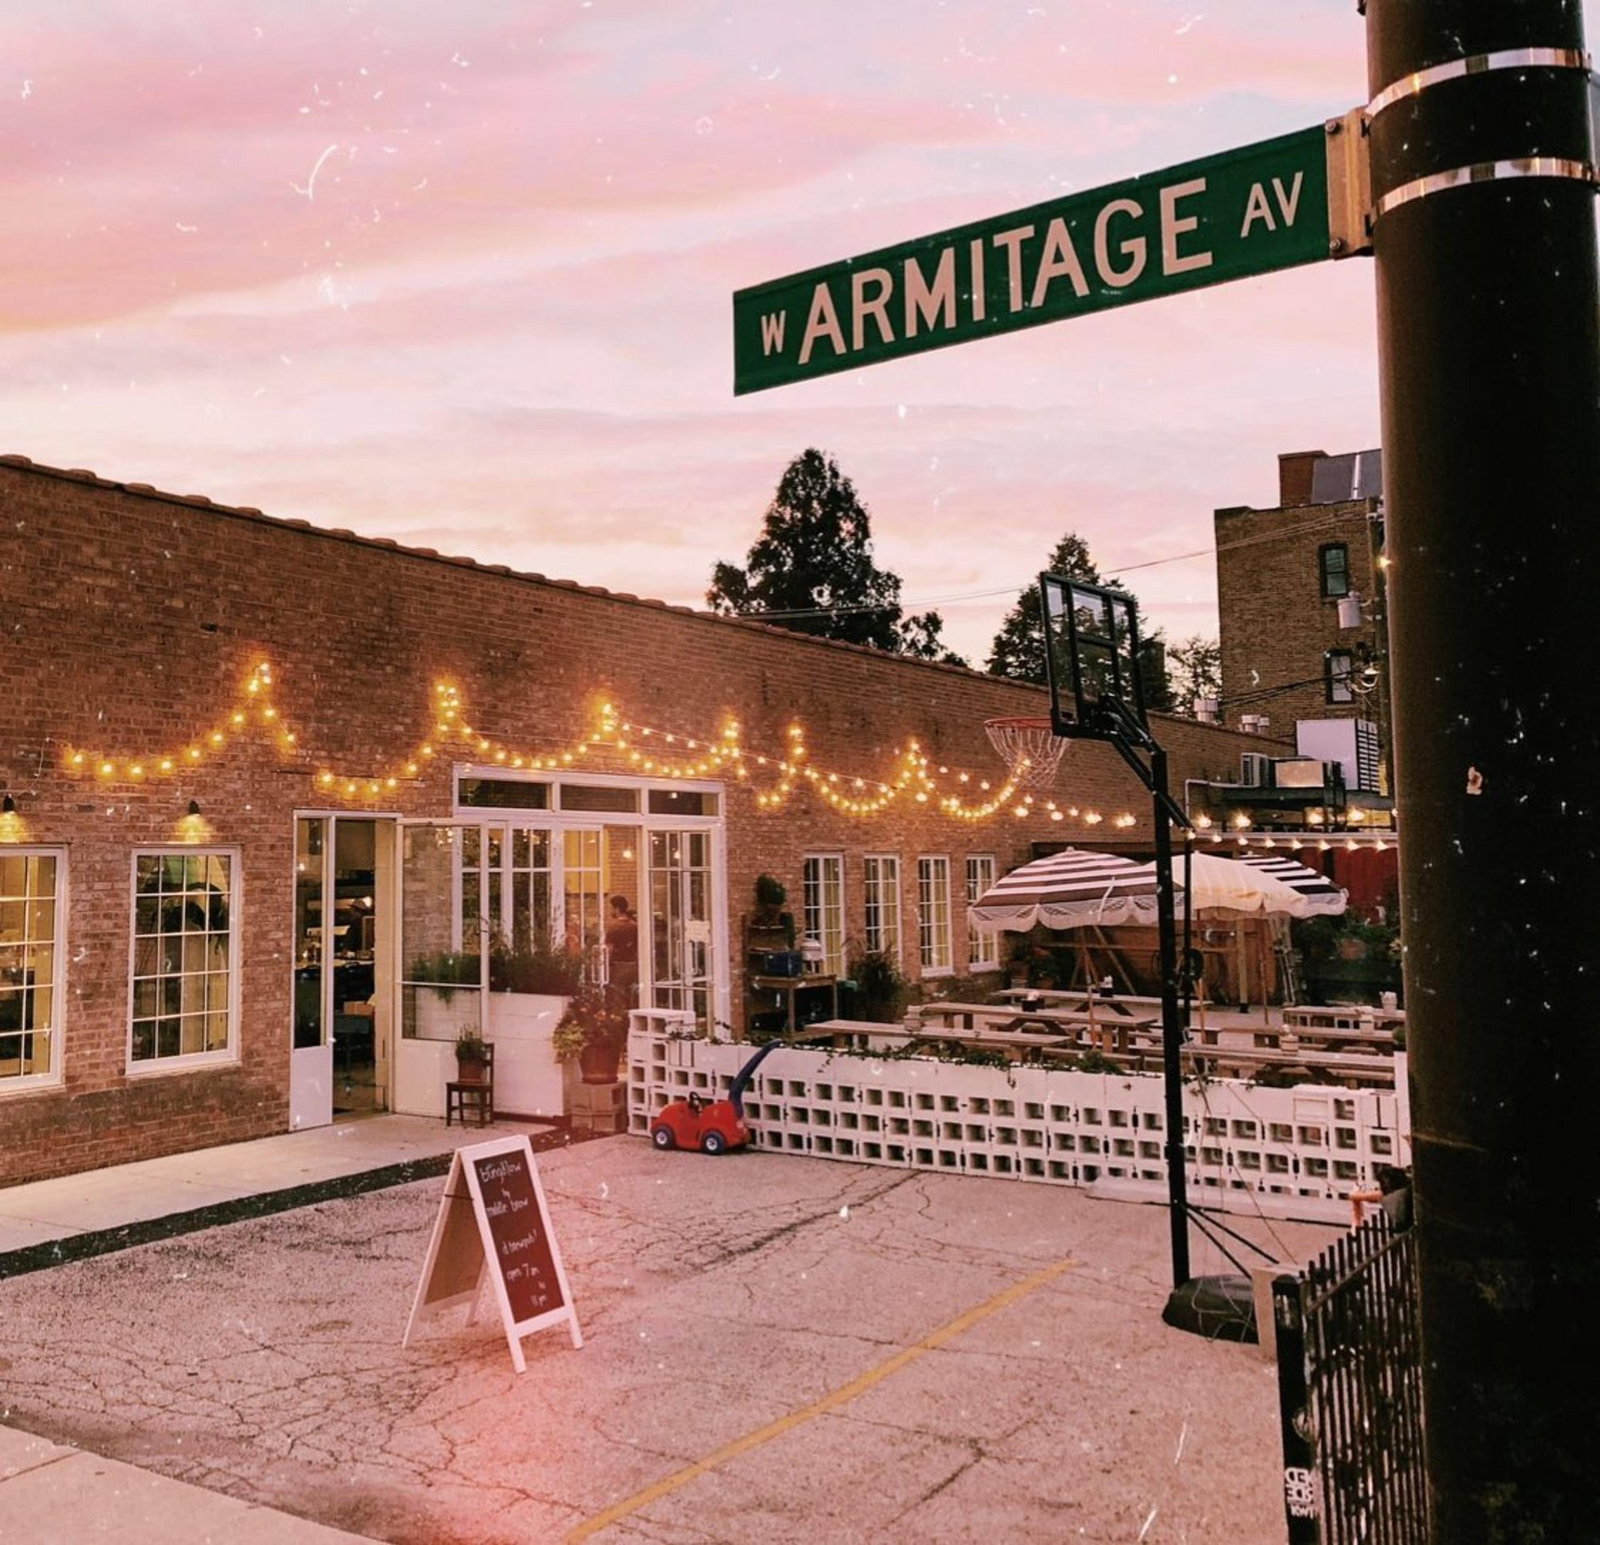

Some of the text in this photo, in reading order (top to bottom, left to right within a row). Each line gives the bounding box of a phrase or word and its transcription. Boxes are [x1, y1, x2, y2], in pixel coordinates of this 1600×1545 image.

[761, 172, 1303, 364] W ARMITAGE AV
